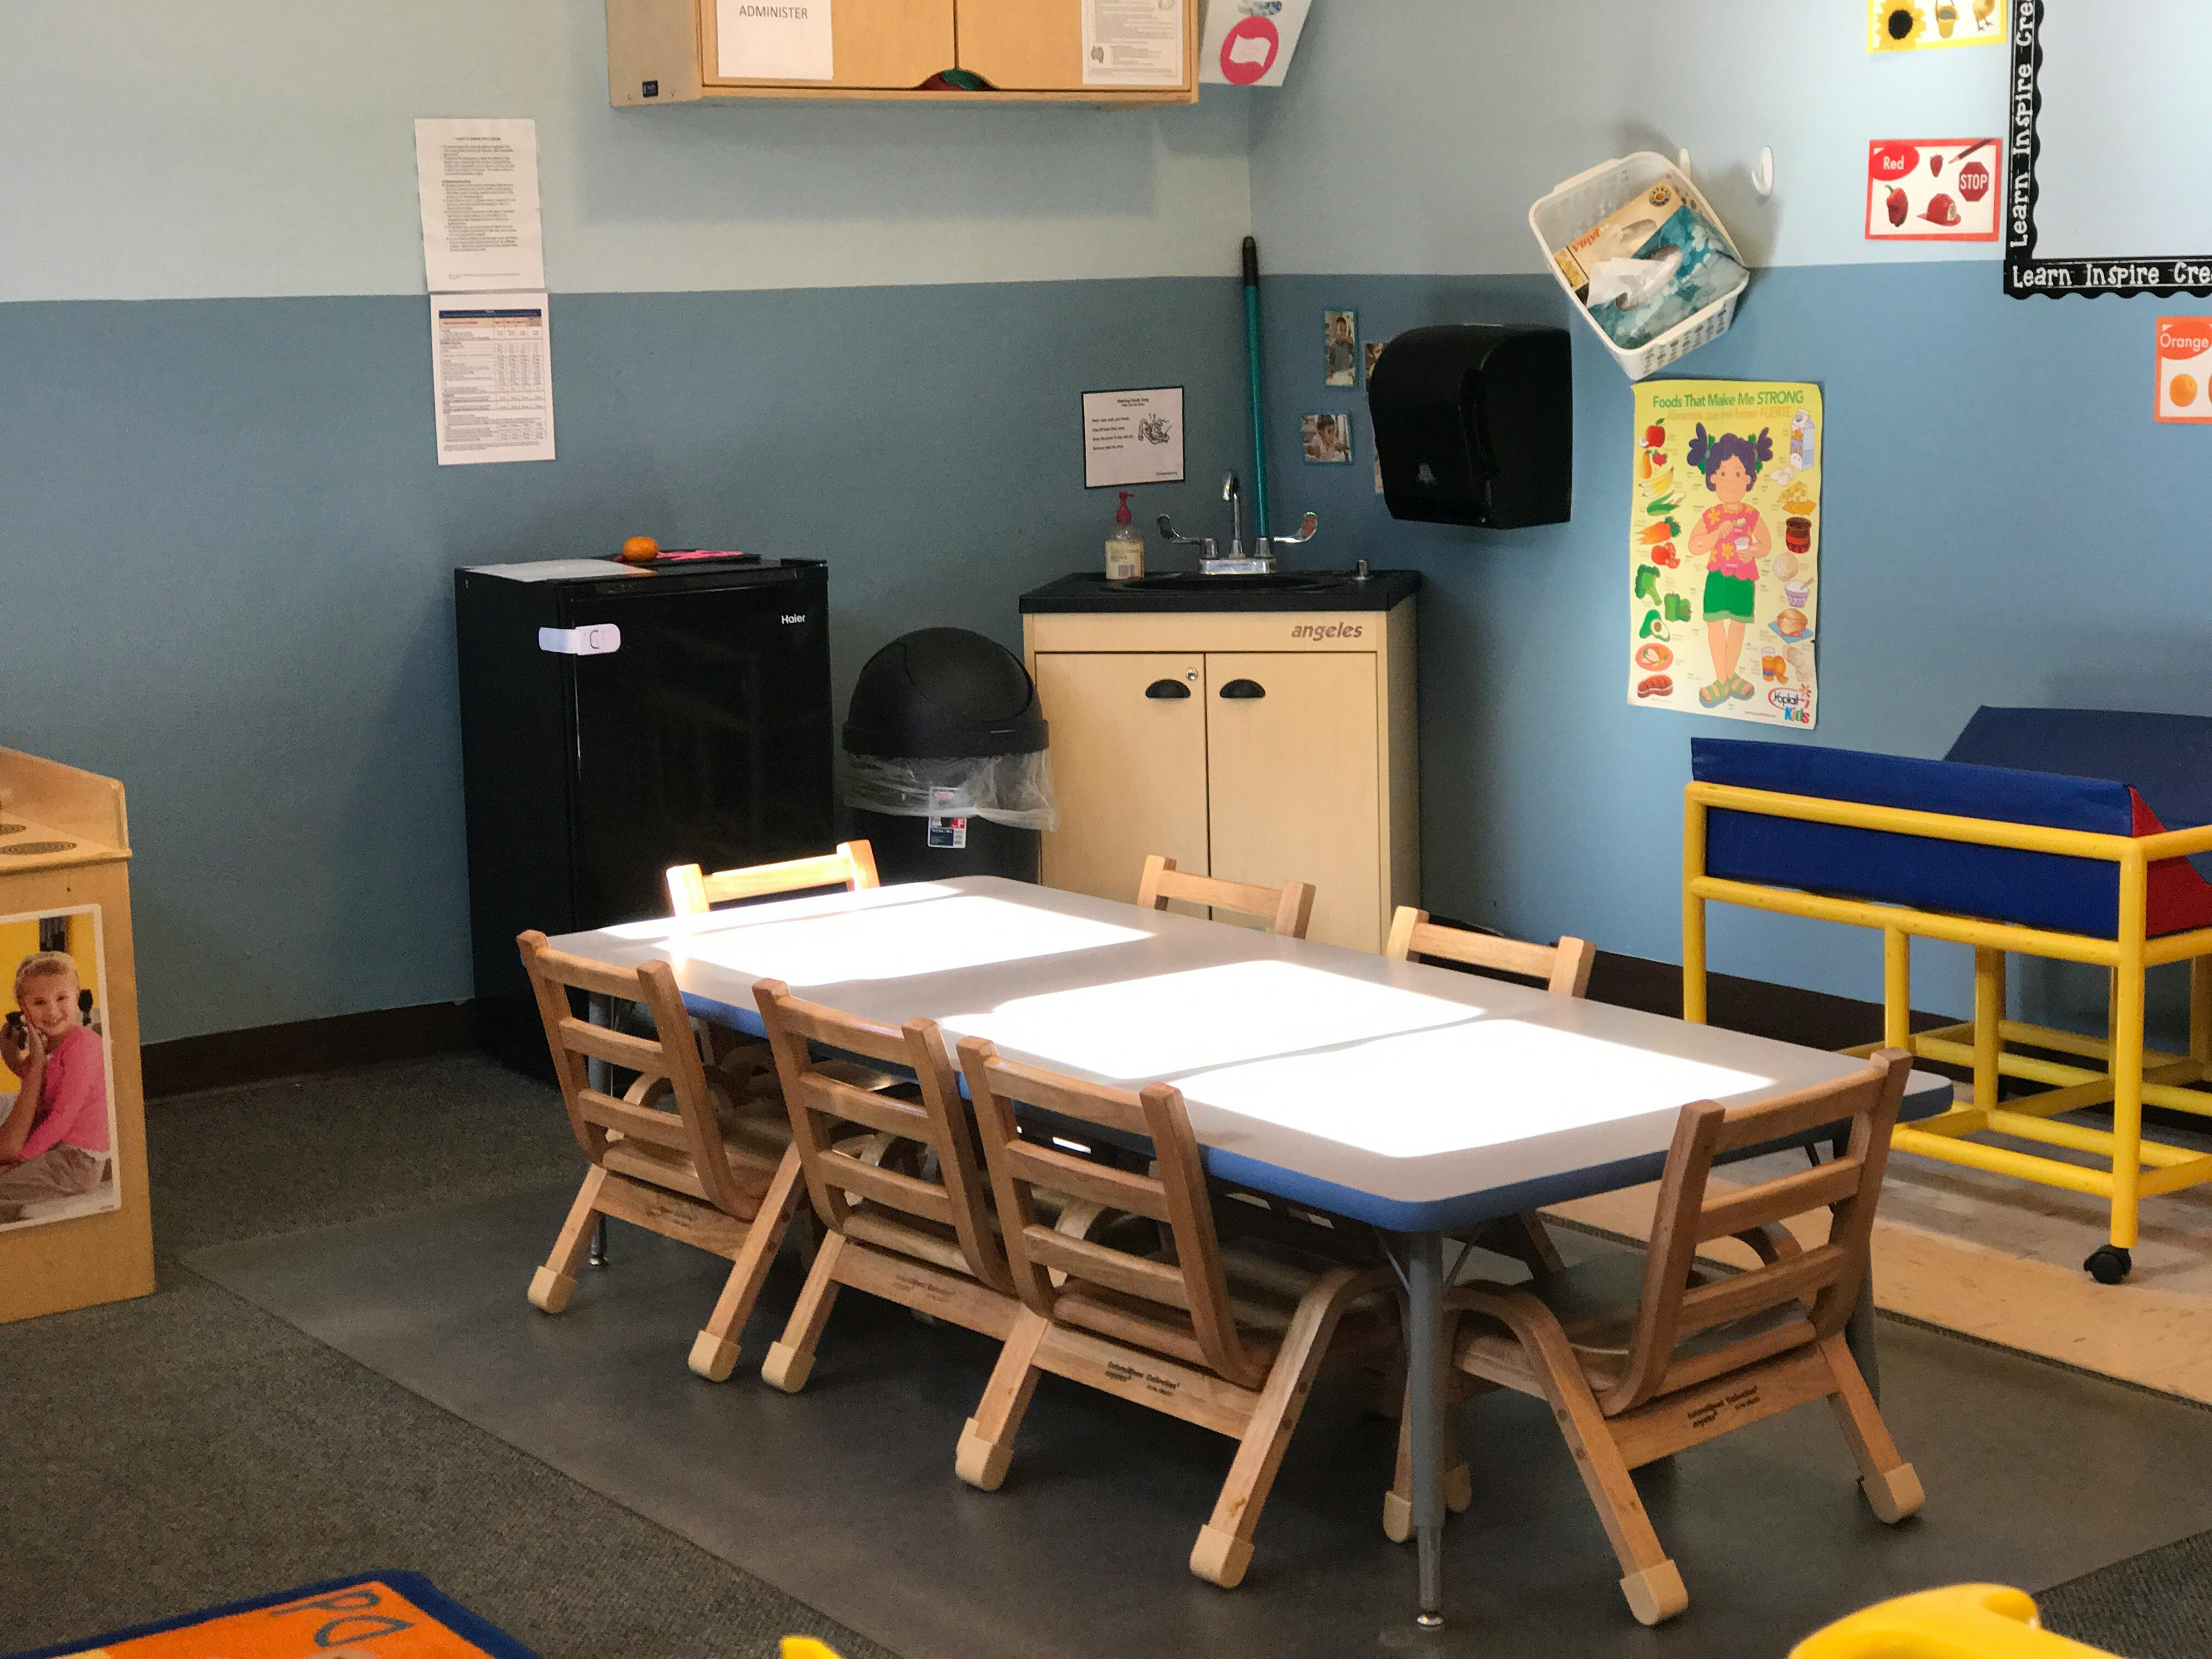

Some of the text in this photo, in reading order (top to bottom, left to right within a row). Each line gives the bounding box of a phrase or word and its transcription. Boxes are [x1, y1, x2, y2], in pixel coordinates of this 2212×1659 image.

[739, 5, 808, 19] ADMINISTER
[2010, 0, 2034, 248] Learn Inspire Cre
[1883, 156, 1904, 170] Red
[1960, 174, 1988, 190] STOP
[2012, 261, 2212, 288] Learn Inspire Cre
[2160, 333, 2209, 352] Orange
[1653, 390, 1804, 408] Foods That Make Me STRONG
[781, 613, 805, 624] Haier
[1291, 621, 1363, 641] angeles
[1773, 691, 1800, 707] Yoplait
[1785, 707, 1810, 724] Kids
